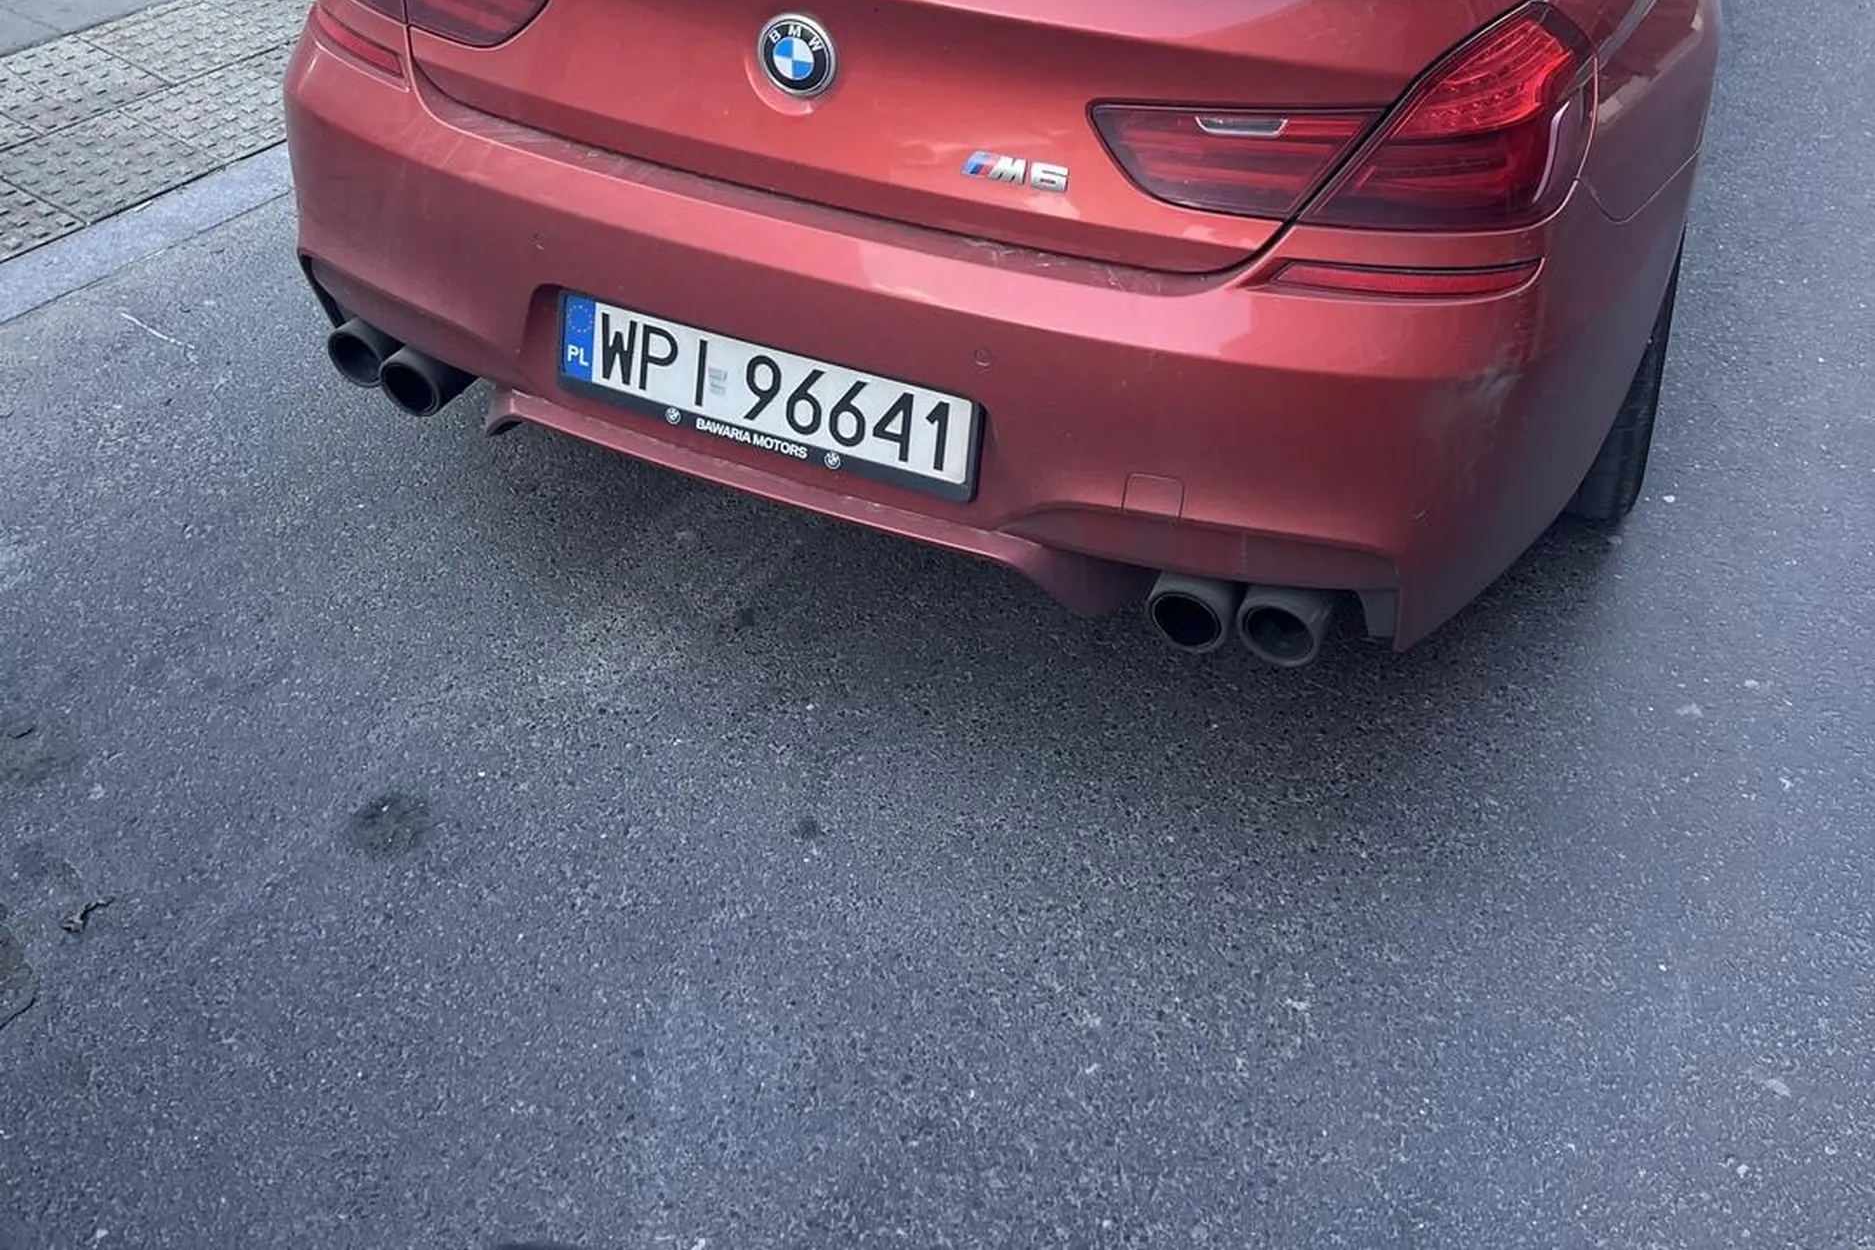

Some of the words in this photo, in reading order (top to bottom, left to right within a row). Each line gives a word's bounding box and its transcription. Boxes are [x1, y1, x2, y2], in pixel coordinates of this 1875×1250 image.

[767, 24, 824, 52] BMW
[567, 344, 590, 367] PL
[601, 312, 709, 408] WPI
[743, 354, 951, 472] 96641
[695, 417, 751, 445] BAWARIA
[752, 434, 808, 460] MOTORS
